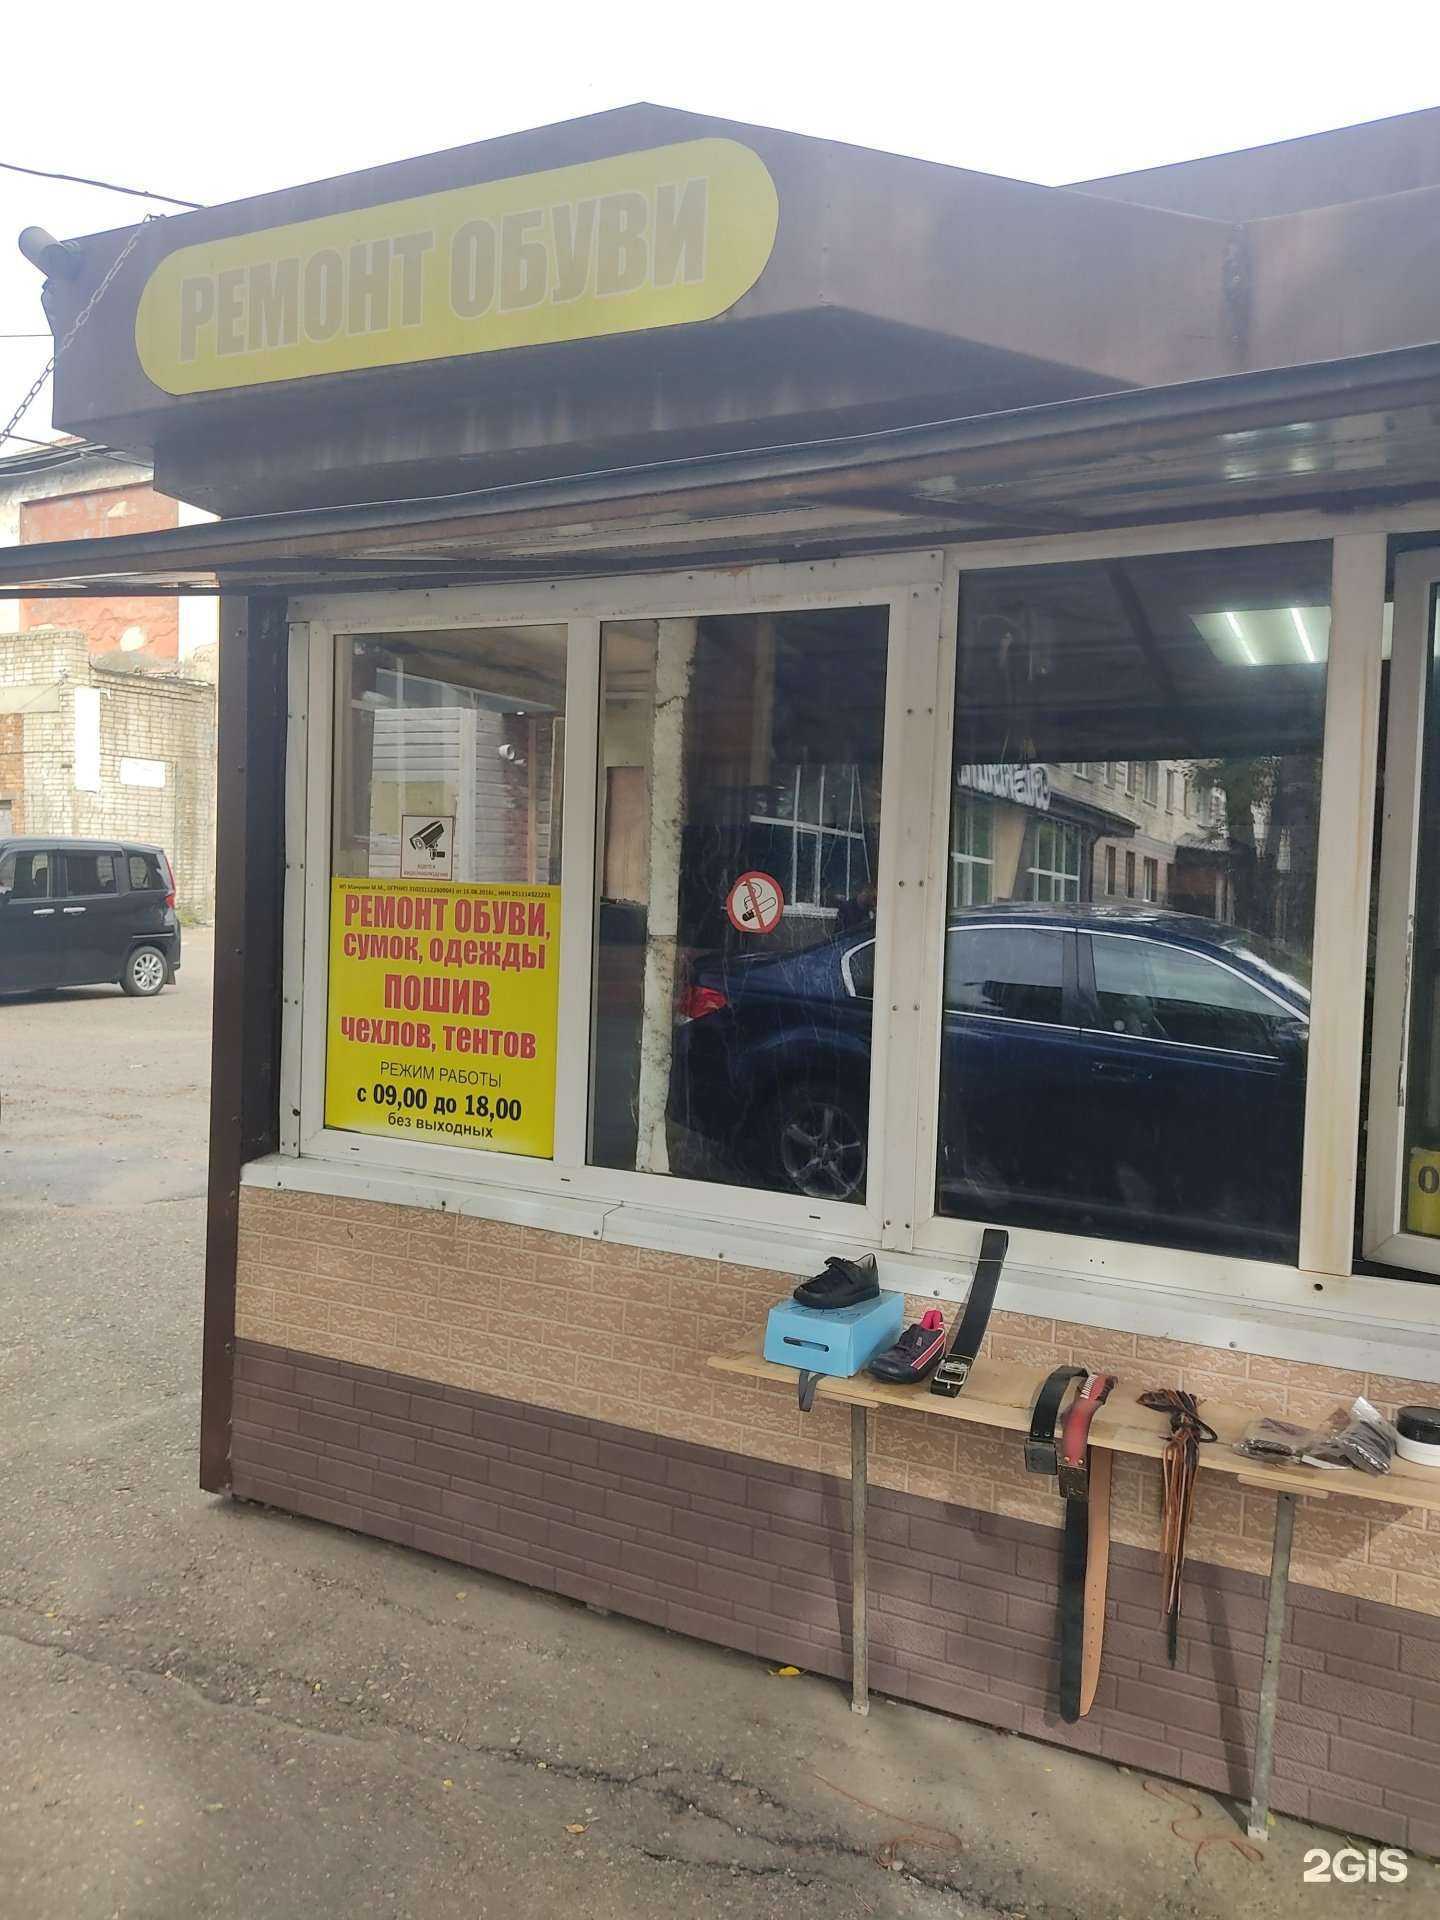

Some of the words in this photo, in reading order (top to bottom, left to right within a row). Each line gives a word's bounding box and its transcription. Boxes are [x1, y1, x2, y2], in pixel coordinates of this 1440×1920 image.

[178, 229, 435, 363] РЕМОНТ
[448, 176, 709, 320] ОБУВИ
[344, 894, 448, 931] РЕМОНТ
[454, 899, 550, 940] ОБУВИ,
[343, 933, 424, 964] сумок,
[429, 938, 546, 972] одежды
[384, 974, 491, 1016] ПОШИВ
[341, 1016, 436, 1052] чехлов,
[442, 1026, 537, 1059] тентов
[380, 1061, 435, 1081] РЕЖИМ
[439, 1067, 502, 1088] РАБОТЫ
[357, 1087, 367, 1102] с
[373, 1084, 428, 1111] 09,00
[434, 1096, 457, 1115] до
[465, 1095, 522, 1122] 18,00
[388, 1112, 412, 1128] без
[416, 1120, 493, 1138] выходных
